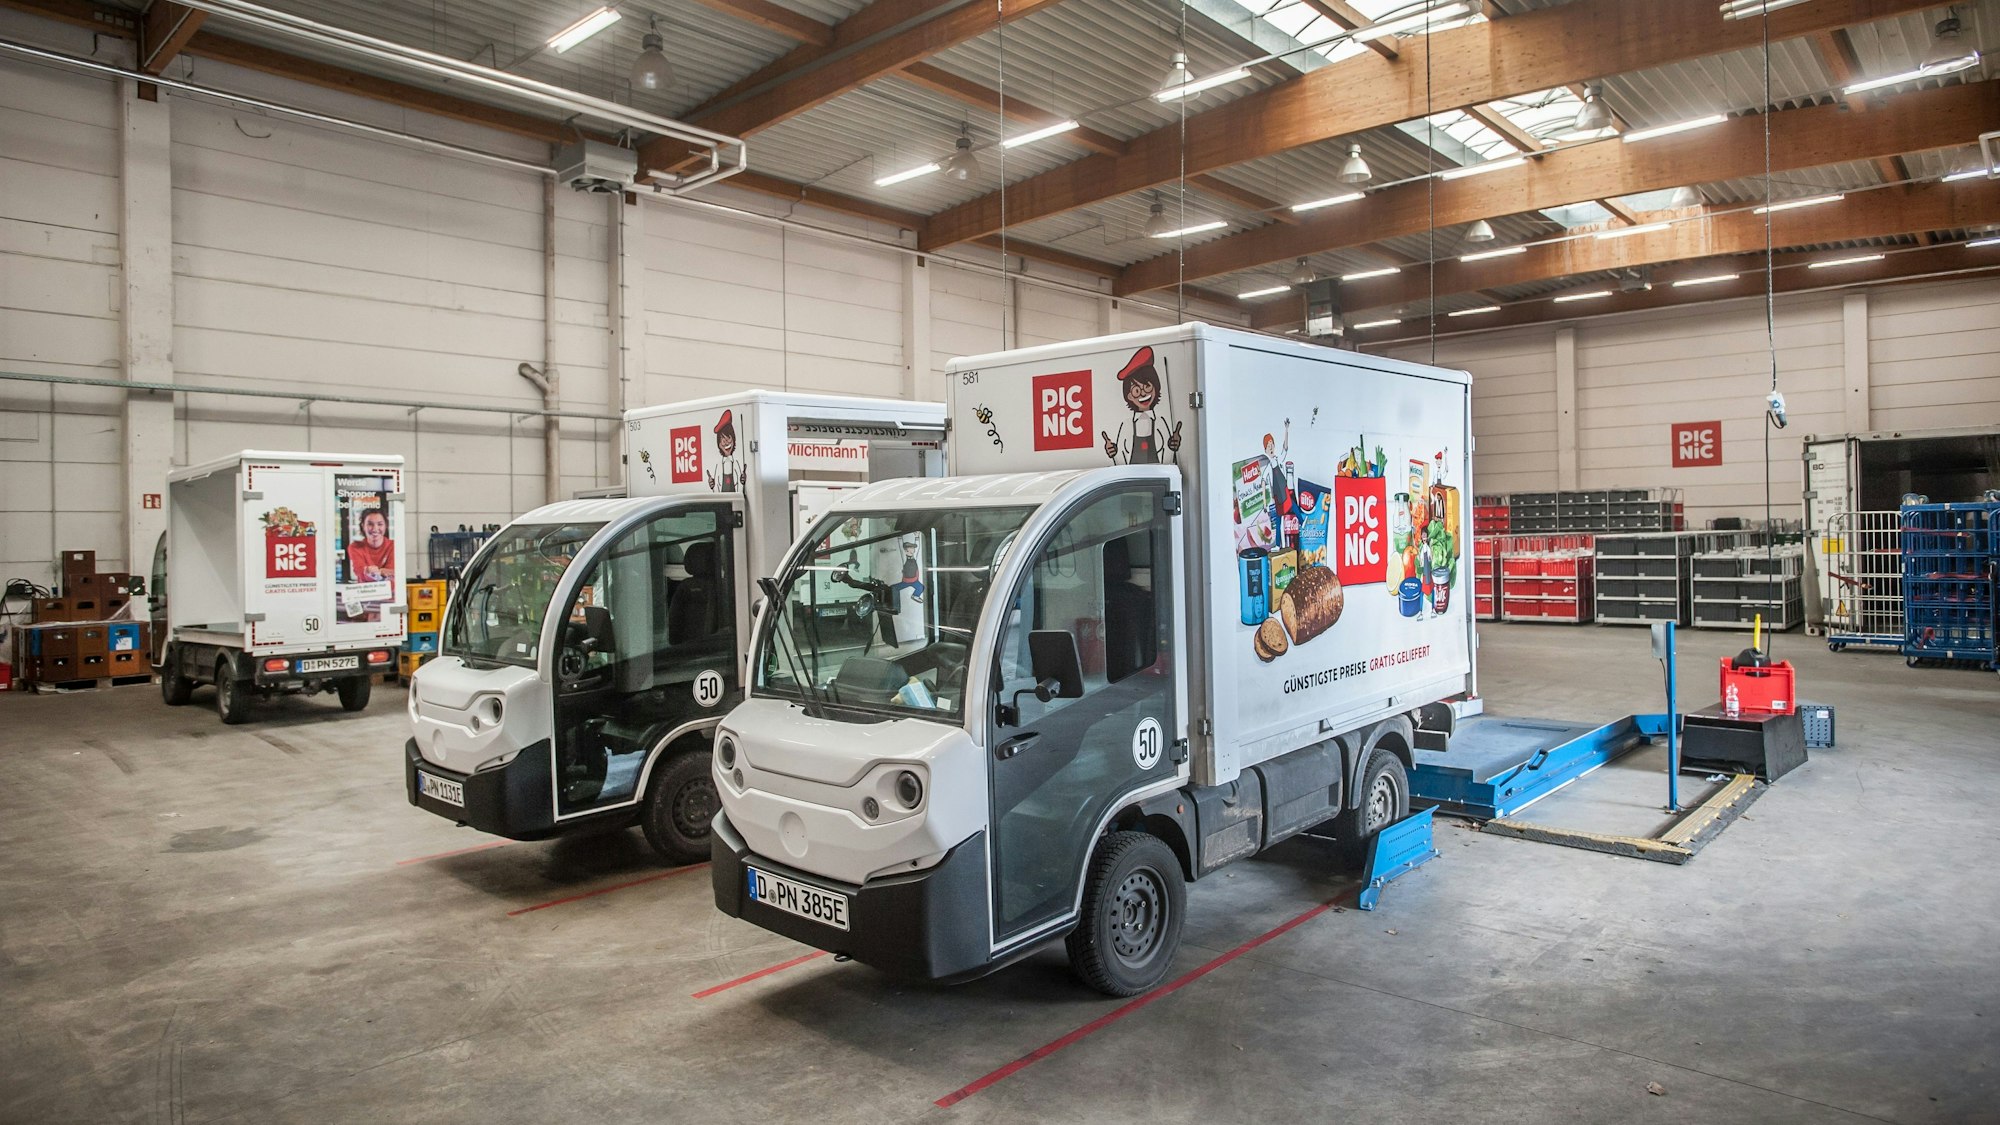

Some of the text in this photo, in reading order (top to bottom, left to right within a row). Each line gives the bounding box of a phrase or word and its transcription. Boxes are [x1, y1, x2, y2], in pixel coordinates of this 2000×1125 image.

[963, 372, 979, 385] 581
[1042, 385, 1083, 412] PIC
[630, 421, 641, 431] 503
[675, 436, 697, 455] PIC
[1679, 429, 1714, 445] PIC
[337, 478, 366, 486] Werde
[337, 489, 376, 499] Shopper
[1344, 495, 1379, 530] PIC
[275, 543, 307, 557] PIC
[305, 618, 319, 631] 50
[1284, 645, 1431, 694] GÜNSTIGSTE PREISE GRATIS GELIEFERT
[700, 677, 717, 700] 50
[1139, 727, 1156, 760] 50
[757, 875, 846, 926] D PN 385E
